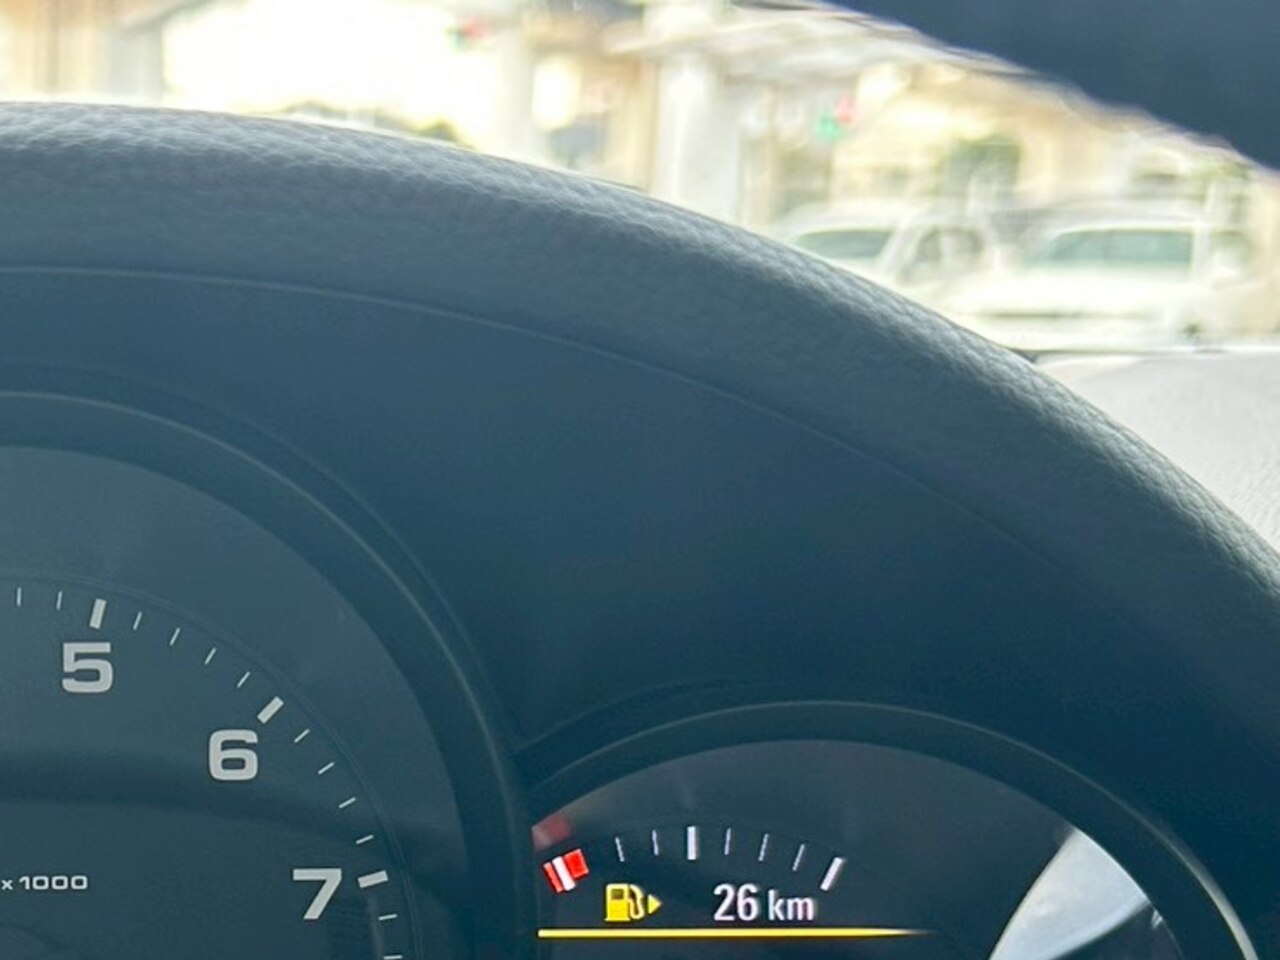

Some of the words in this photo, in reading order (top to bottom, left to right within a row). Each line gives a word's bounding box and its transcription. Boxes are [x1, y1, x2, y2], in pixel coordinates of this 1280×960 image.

[63, 642, 112, 692] 5
[209, 730, 258, 780] 6
[20, 876, 87, 889] 1000
[293, 869, 341, 919] 7
[714, 884, 759, 920] 26
[769, 884, 814, 920] km
